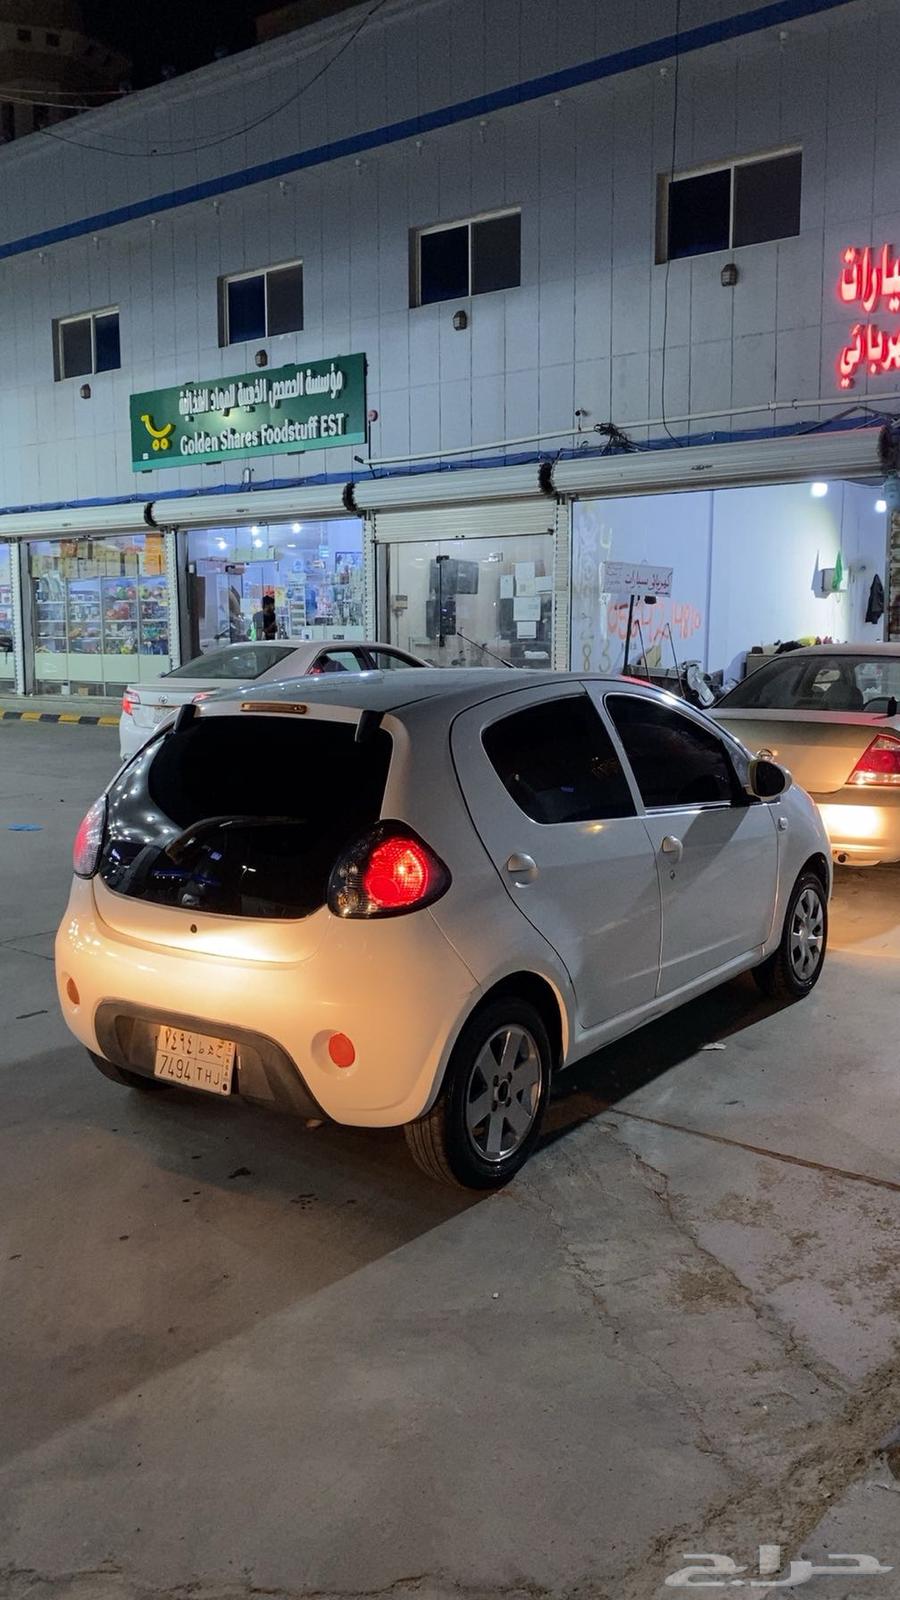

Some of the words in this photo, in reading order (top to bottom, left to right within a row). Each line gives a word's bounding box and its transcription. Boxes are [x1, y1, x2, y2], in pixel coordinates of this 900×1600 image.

[841, 243, 900, 312] يارات
[305, 363, 343, 399] مؤسسة
[180, 432, 219, 456] Golden
[220, 426, 258, 450] Shares
[261, 416, 319, 447] Foodstuff
[321, 412, 345, 437] EST
[159, 1054, 191, 1081] 7494
[196, 1067, 220, 1085] THJ
